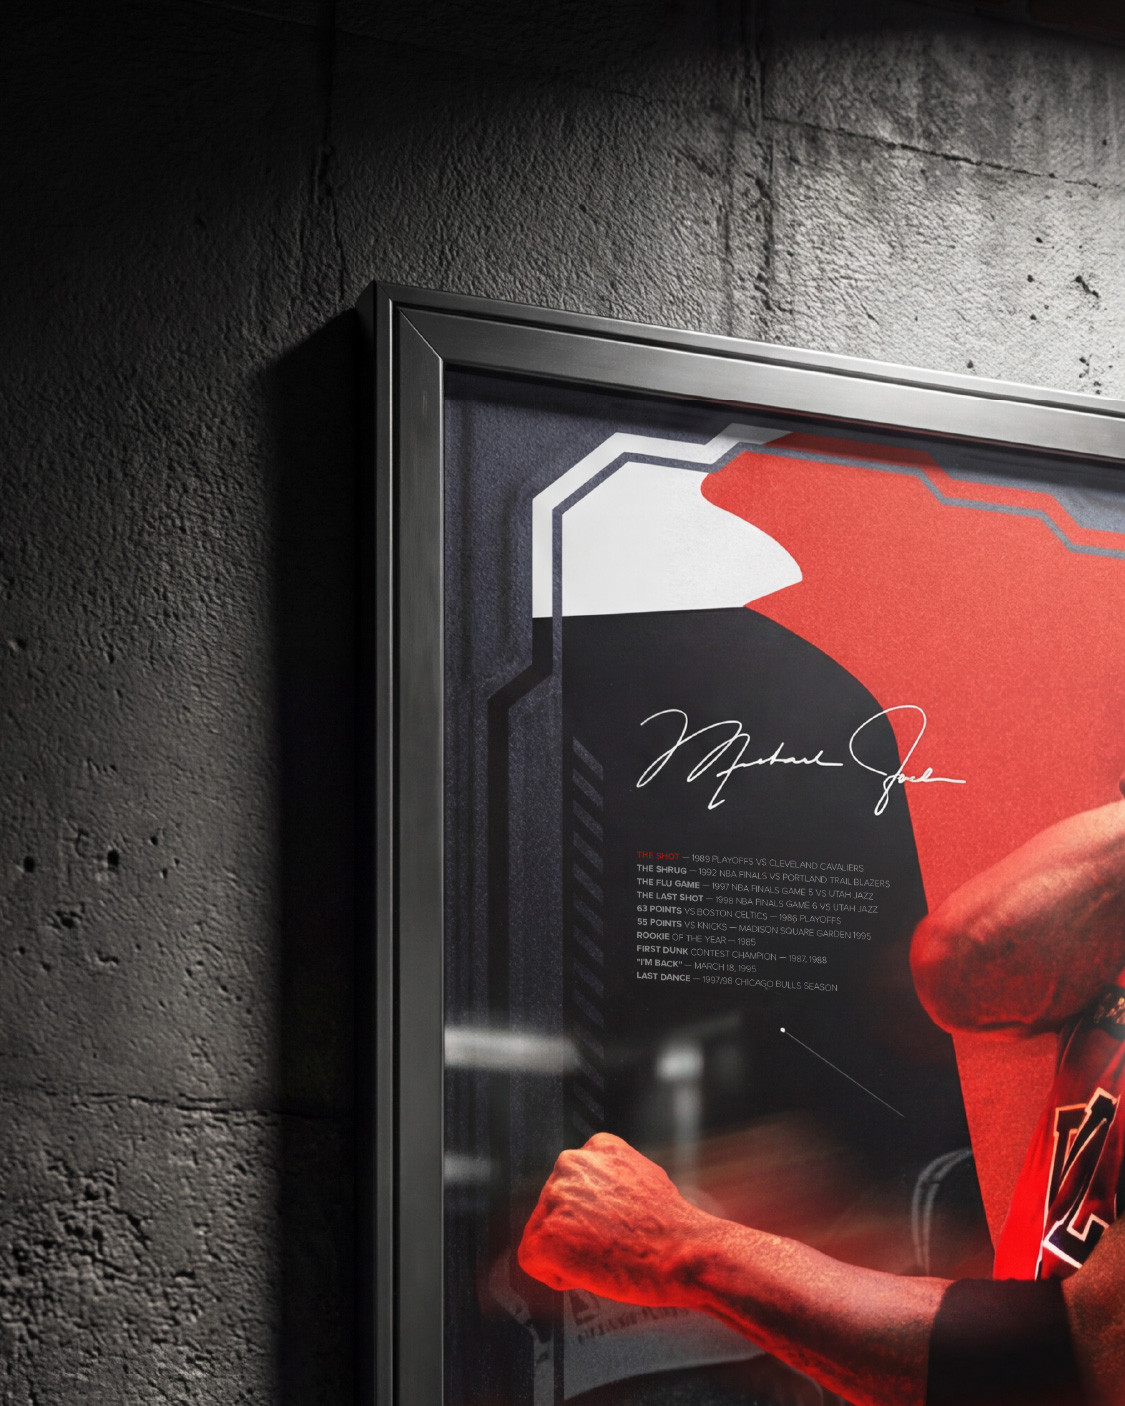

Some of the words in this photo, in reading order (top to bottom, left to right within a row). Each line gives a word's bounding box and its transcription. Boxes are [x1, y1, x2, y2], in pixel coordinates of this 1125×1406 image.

[637, 851, 653, 859] THE
[656, 852, 680, 861] SHOT
[692, 854, 710, 862] 1989
[712, 856, 753, 865] PLAYOFFS
[756, 858, 767, 866] VS
[769, 859, 818, 869] CLEVELAND
[819, 862, 864, 872] CAVALIERS
[637, 864, 653, 872] THE
[656, 866, 687, 874] SHRUG
[699, 868, 717, 876] 1992
[719, 870, 737, 878] NBA
[739, 871, 767, 880] FINALS
[769, 873, 780, 881] VS
[782, 874, 827, 884] PORTLAND
[830, 877, 853, 885] TRAIL
[854, 878, 890, 888] BLAZERS
[637, 878, 653, 886] THE
[656, 879, 672, 887] FLU
[674, 880, 700, 889] GAME
[712, 883, 729, 891] 1997
[732, 884, 749, 892] NBA
[752, 885, 780, 894] FINALS
[782, 887, 806, 896] GAME
[815, 889, 826, 897] VS
[829, 890, 851, 899] UTAH
[853, 892, 874, 900] JAZZ
[637, 891, 653, 899] THE
[656, 893, 677, 901] LAST
[679, 894, 703, 902] SHOT
[716, 896, 734, 904] 1998
[735, 897, 753, 905] NBA
[755, 899, 784, 907] FINALS
[786, 901, 810, 909] GAME
[812, 902, 818, 910] 6
[833, 904, 856, 912] UTAH
[858, 905, 879, 913] JAZZ
[650, 905, 682, 914] POINTS
[697, 908, 733, 918] BOSTON
[735, 911, 768, 920] CELTICS
[779, 913, 797, 921] 1986
[799, 915, 842, 924] PLAYOFFS
[637, 918, 648, 926] 55
[650, 919, 682, 928] POINTS
[684, 921, 695, 929] VS
[697, 922, 727, 931] KNICKS
[739, 924, 778, 934] MADISON
[780, 927, 814, 936] SQUARE
[816, 929, 851, 938] GARDEN
[853, 932, 872, 940] 1995
[637, 931, 670, 940] ROOKIE
[705, 936, 727, 944] YEAR
[737, 938, 756, 946] 1985
[637, 945, 661, 953] FIRST
[663, 946, 689, 955] DUNK
[691, 948, 729, 958] CONTEST
[732, 951, 777, 961] CHAMPION
[789, 954, 808, 964] 1987,
[637, 958, 652, 966] "I'M
[655, 959, 682, 968] BACK"
[694, 962, 725, 971] MARCH
[727, 964, 737, 972] 18,
[738, 965, 756, 973] 1995
[637, 972, 658, 980] LAST
[660, 973, 691, 982] DANCE
[702, 976, 733, 985] 1997/98
[735, 978, 773, 987] CHICAGO
[775, 981, 802, 989] BULLS
[804, 982, 838, 991] SEASON
